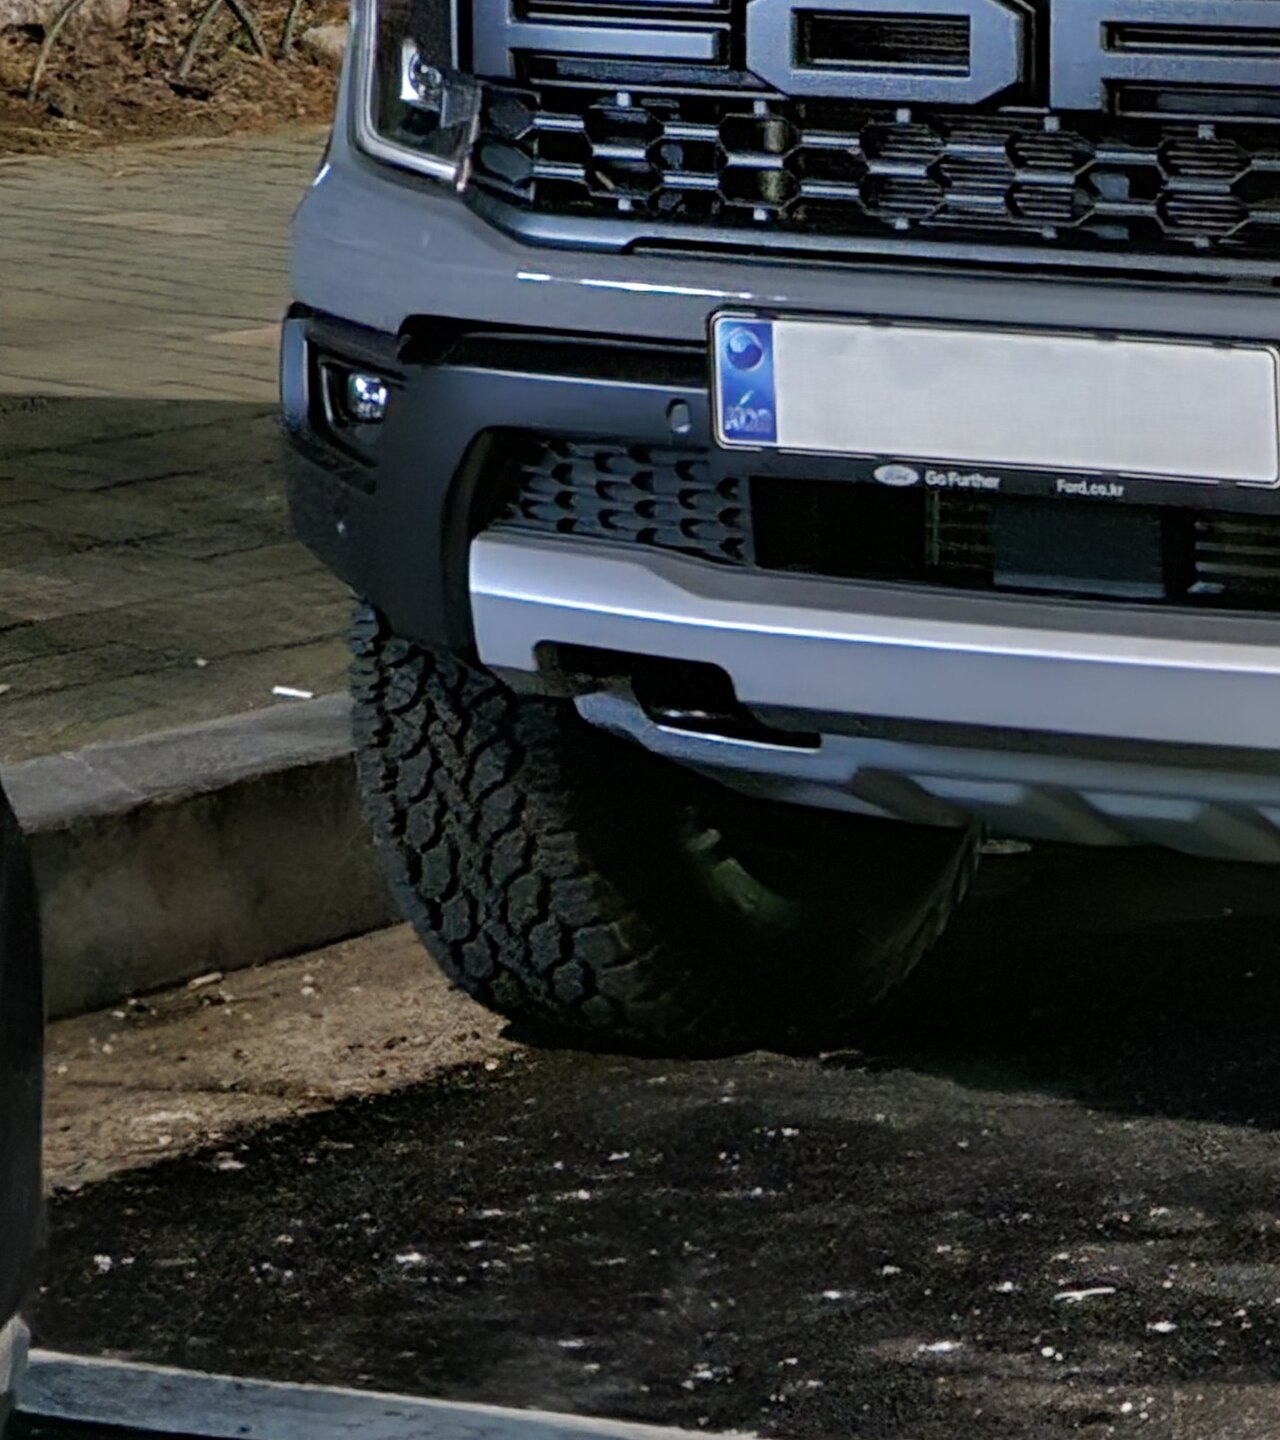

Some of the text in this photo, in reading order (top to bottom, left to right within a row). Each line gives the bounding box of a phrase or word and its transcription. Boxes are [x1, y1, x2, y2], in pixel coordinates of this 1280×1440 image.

[925, 471, 1124, 496] Go Further Ford.co.kr
